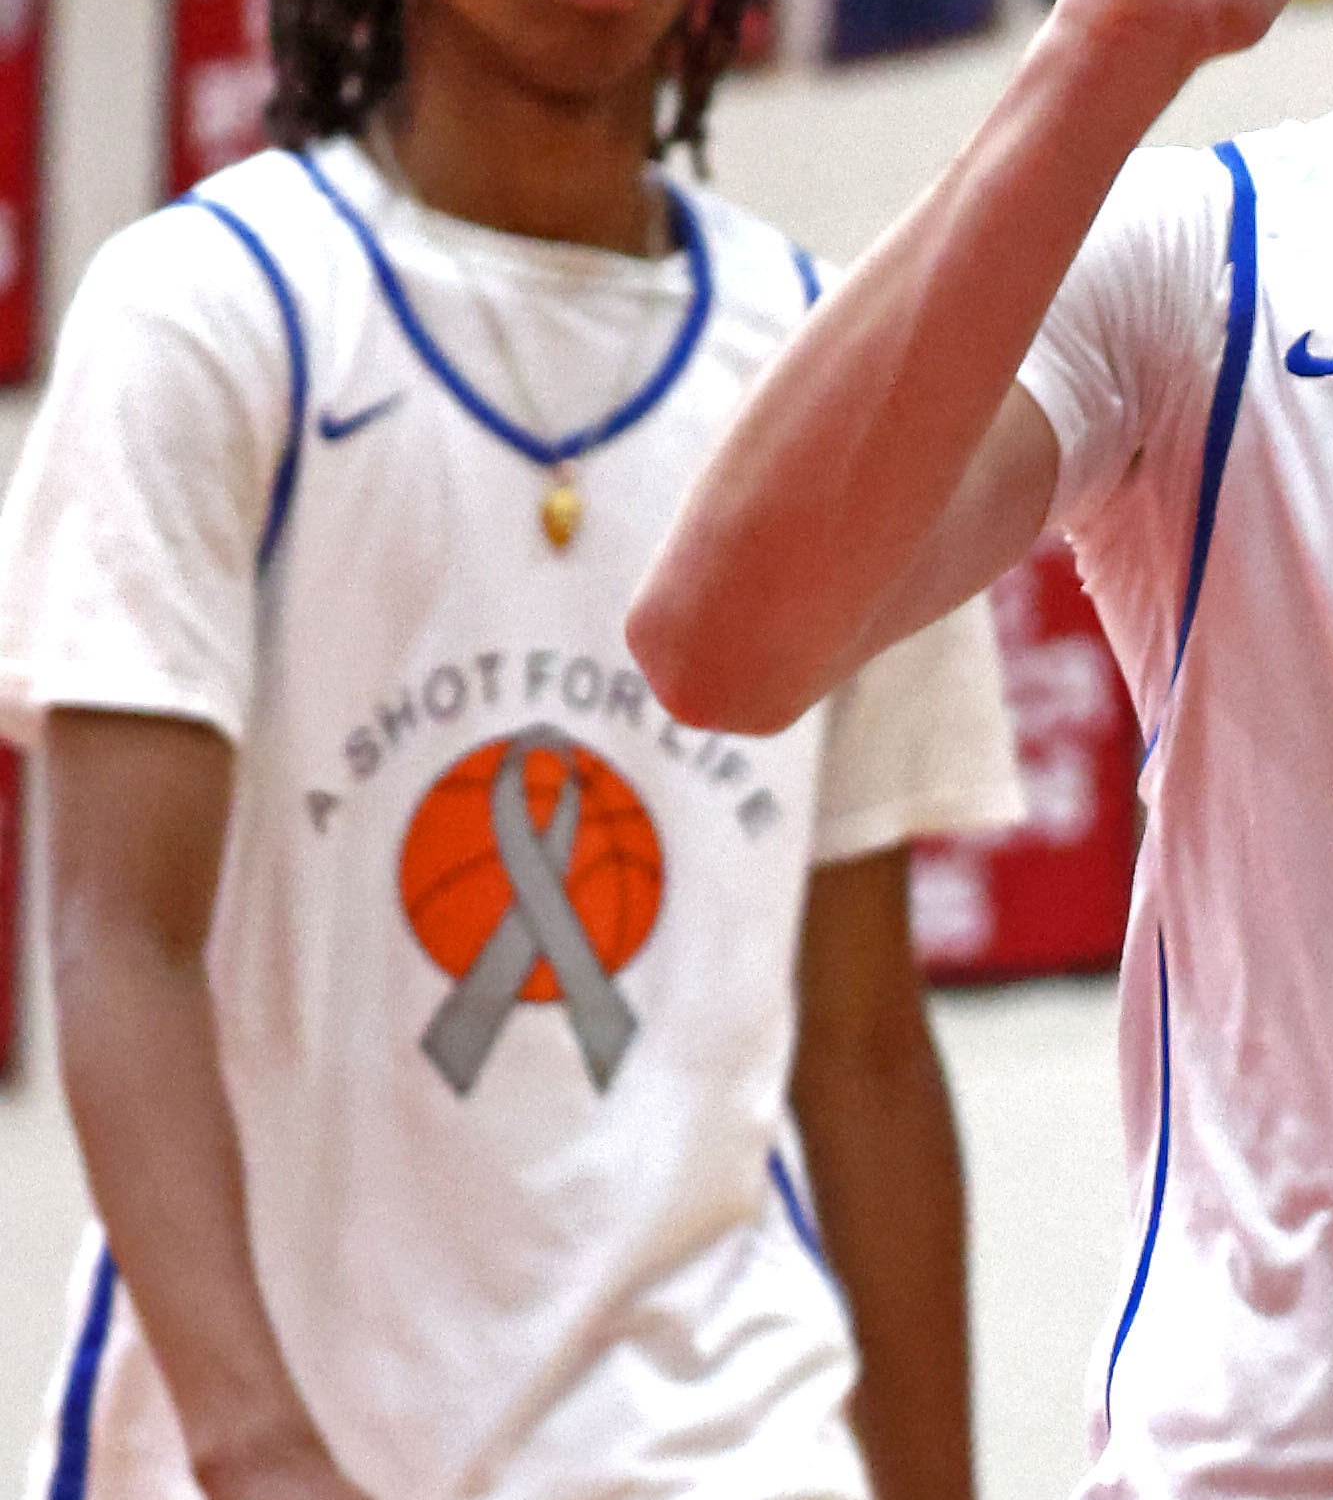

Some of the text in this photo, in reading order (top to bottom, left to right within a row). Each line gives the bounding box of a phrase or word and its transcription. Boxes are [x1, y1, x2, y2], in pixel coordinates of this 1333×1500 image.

[307, 645, 783, 843] A SHOT FOR LIFE
